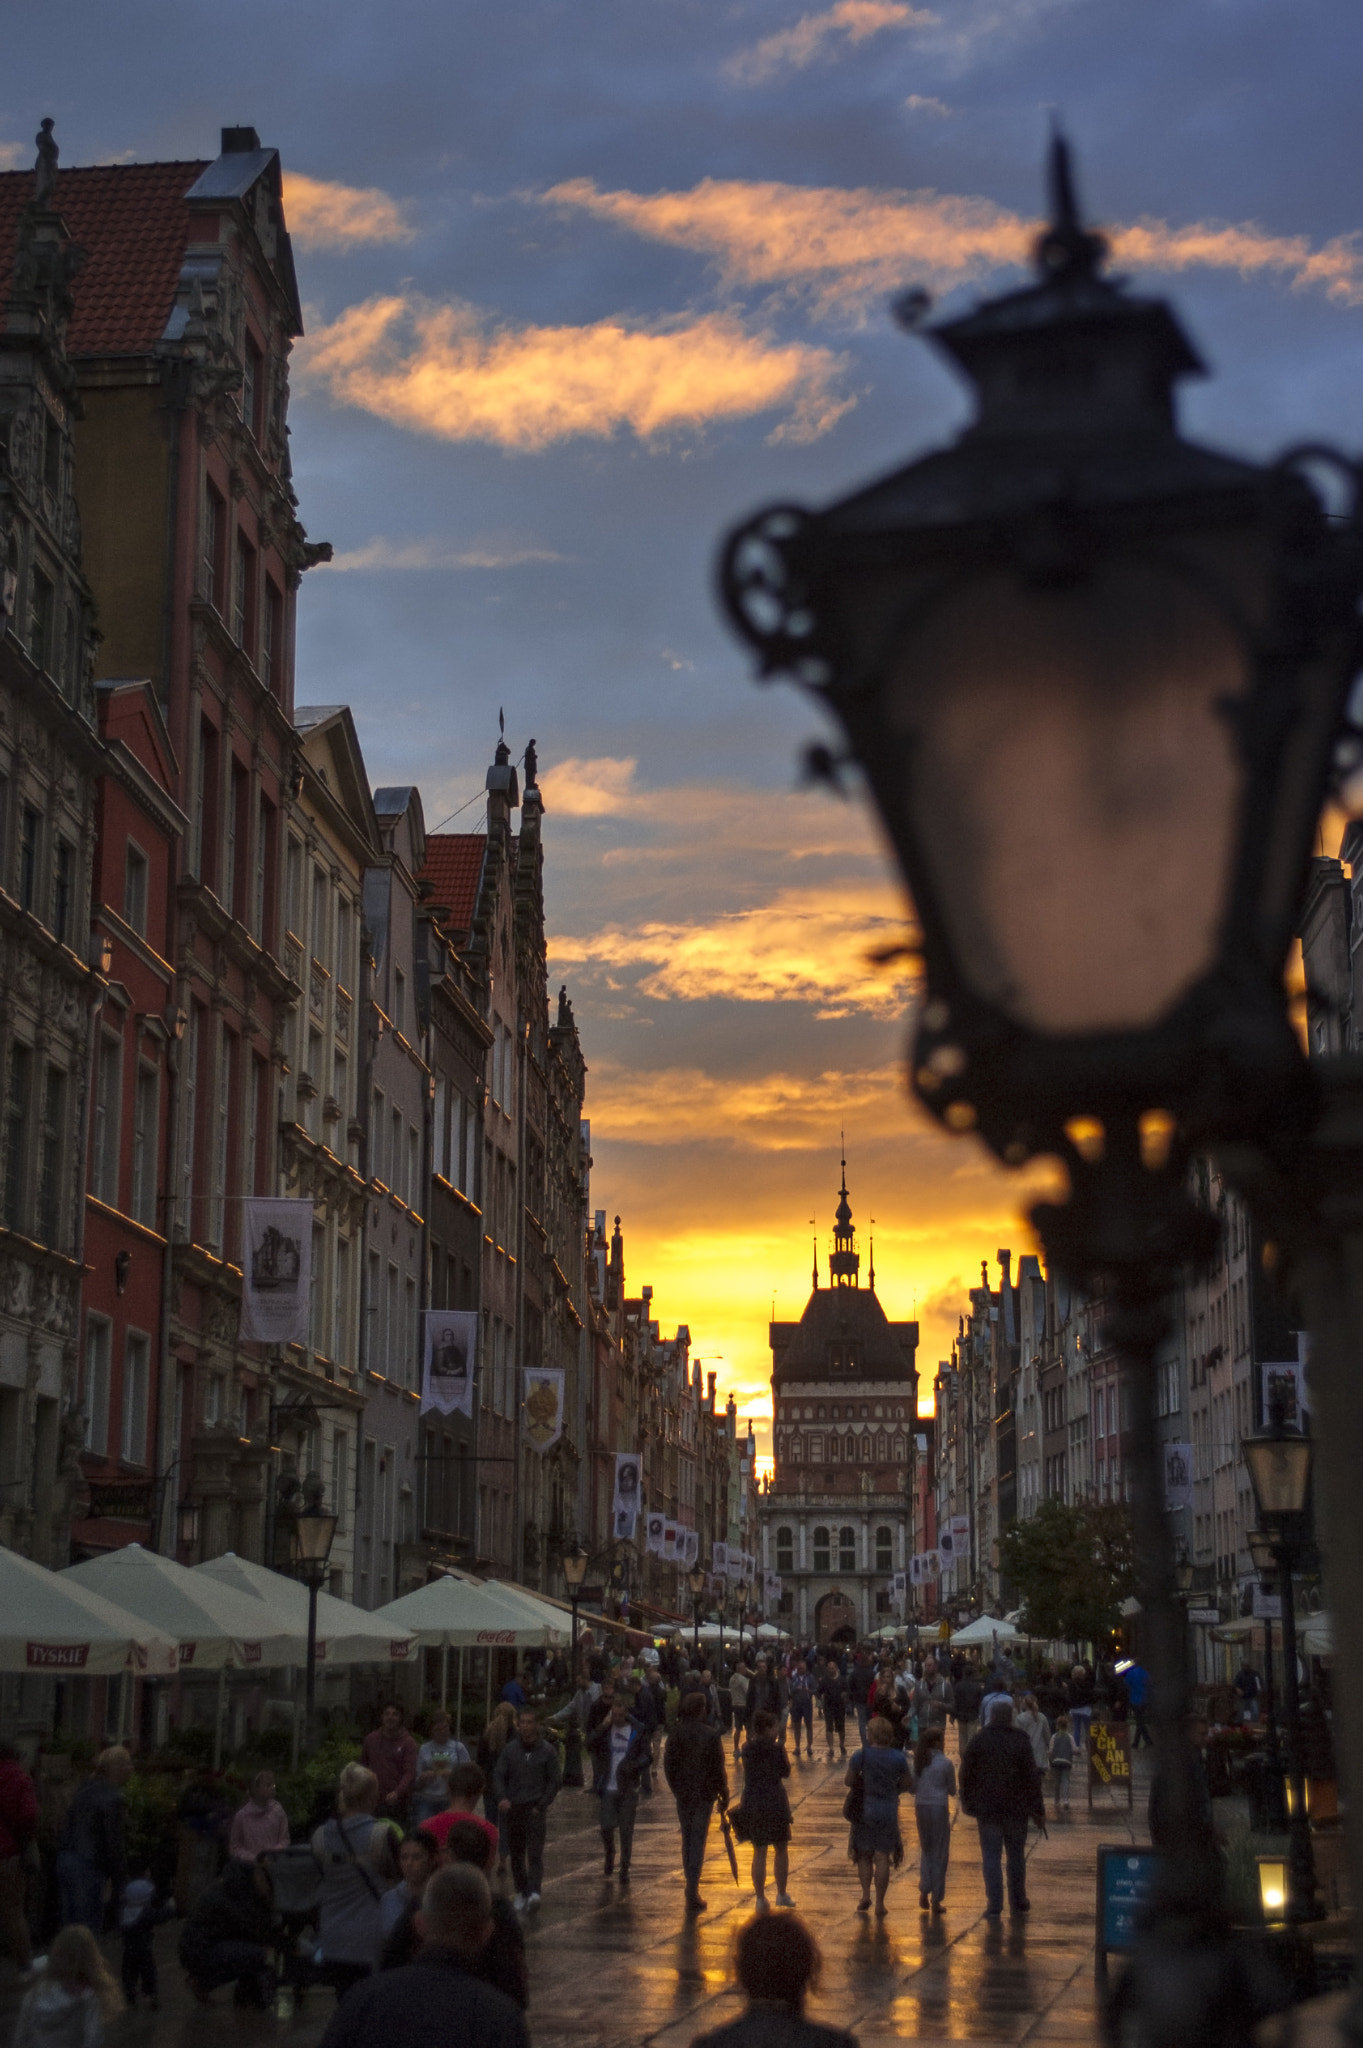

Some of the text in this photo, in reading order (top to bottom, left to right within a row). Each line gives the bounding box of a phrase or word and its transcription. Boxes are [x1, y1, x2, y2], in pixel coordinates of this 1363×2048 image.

[477, 1630, 517, 1643] Coca-Cola
[31, 1646, 85, 1664] TYSKIE
[1089, 1724, 1107, 1737] EX
[1097, 1736, 1116, 1750] CH
[1105, 1749, 1125, 1762] AN
[1111, 1762, 1129, 1776] GE
